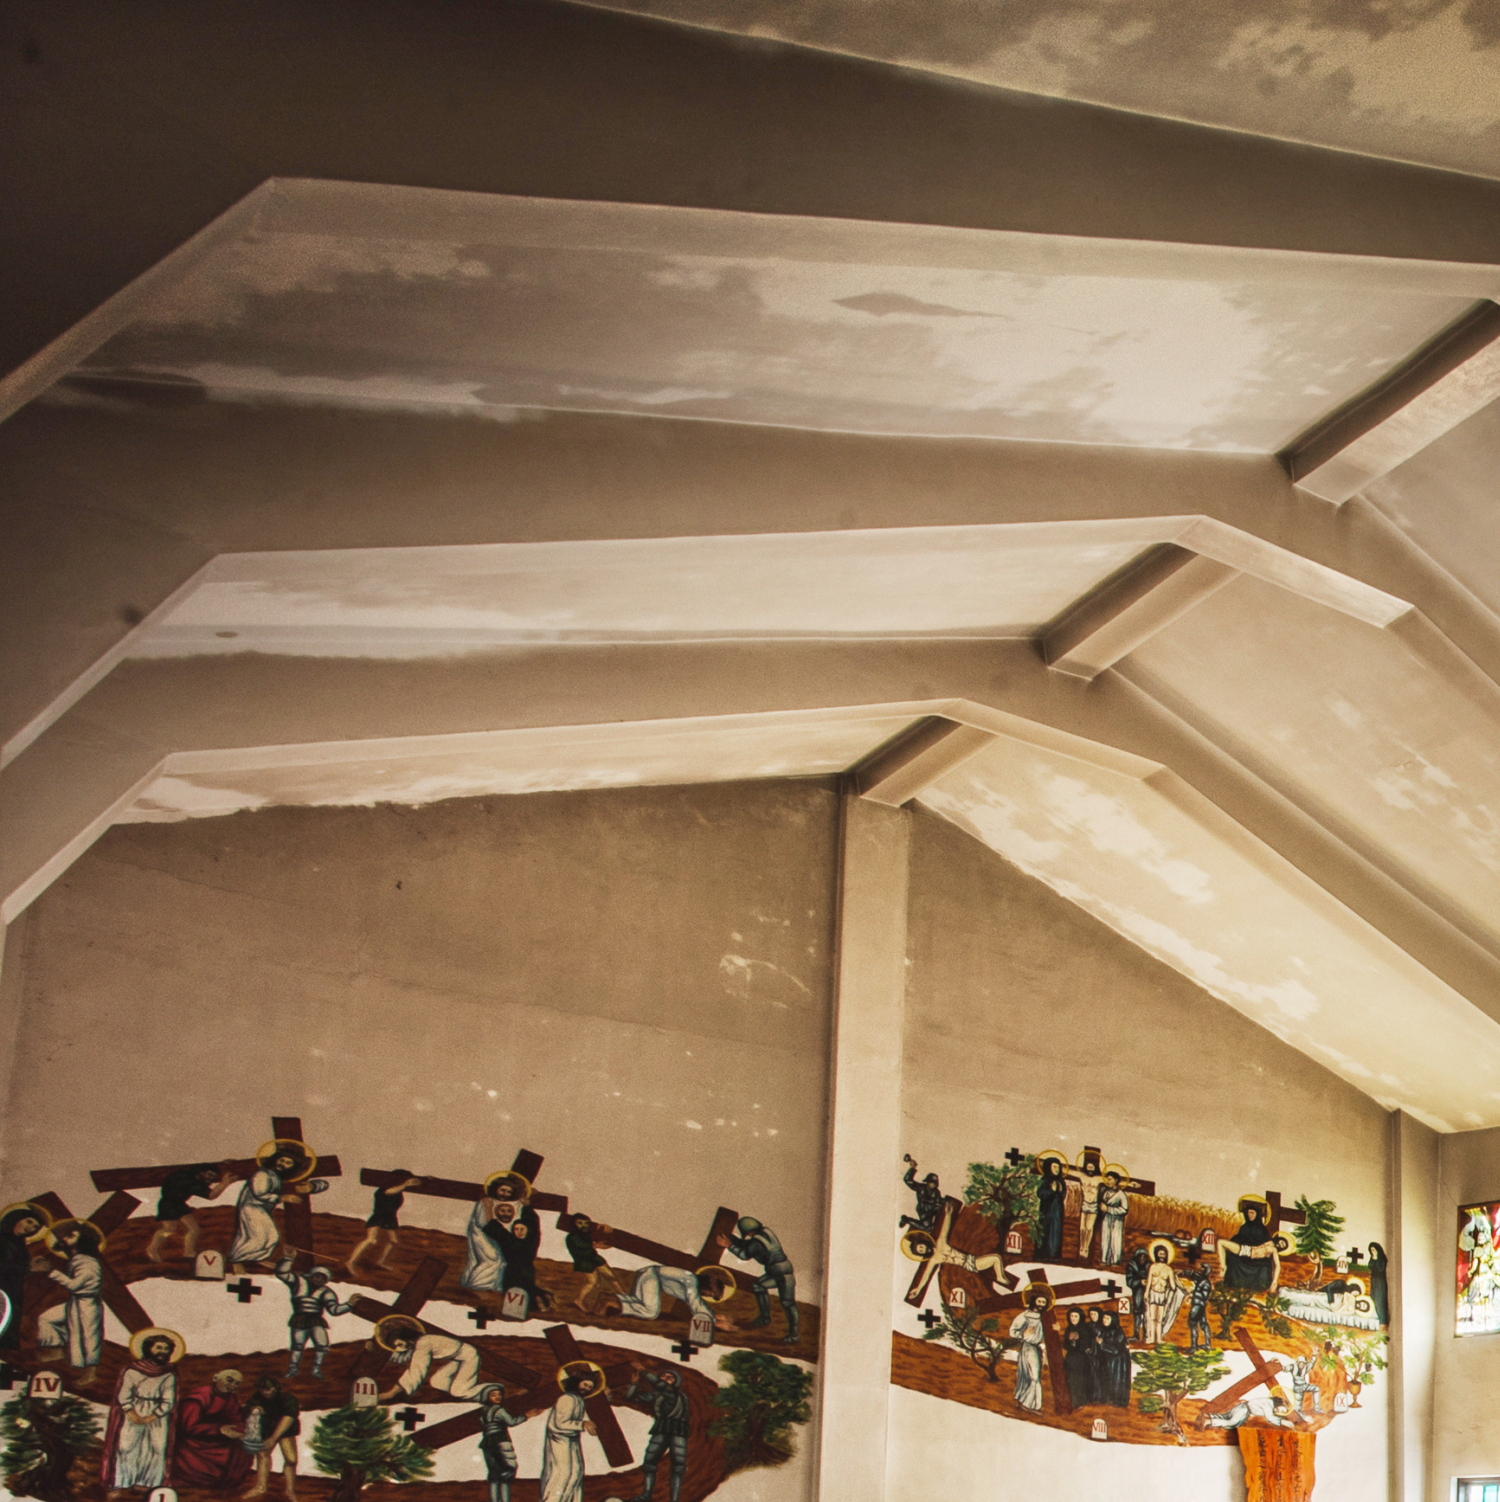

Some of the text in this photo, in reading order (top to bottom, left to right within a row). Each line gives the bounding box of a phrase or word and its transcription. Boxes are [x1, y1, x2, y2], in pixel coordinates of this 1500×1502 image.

[1006, 1234, 1022, 1250] XII
[202, 1254, 218, 1267] V
[506, 1291, 525, 1307] VI
[950, 1290, 965, 1305] XI
[1118, 1300, 1129, 1312] X
[692, 1318, 711, 1333] VII
[34, 1377, 61, 1394] IV
[355, 1382, 376, 1396] III
[1336, 1395, 1346, 1408] IX
